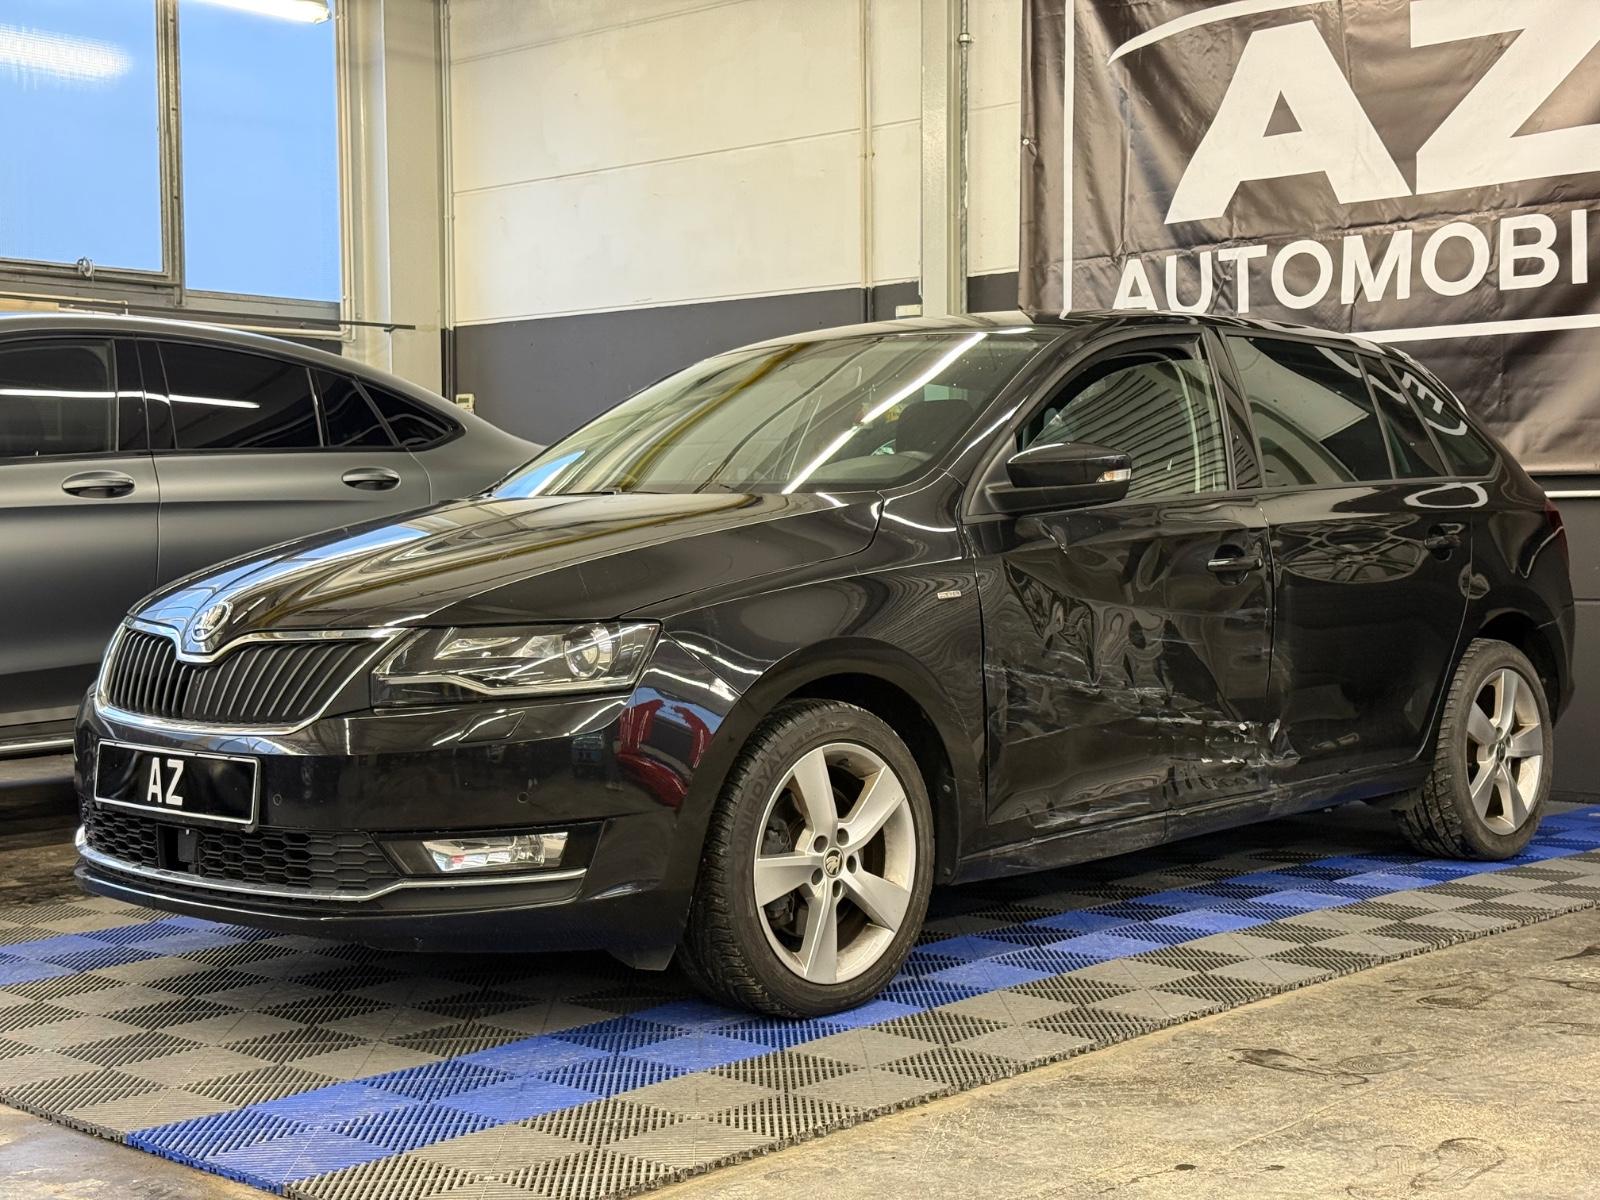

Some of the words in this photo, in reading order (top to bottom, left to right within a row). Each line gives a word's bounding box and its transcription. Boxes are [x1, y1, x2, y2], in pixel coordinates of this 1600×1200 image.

[1164, 0, 1600, 224] AZ
[1113, 210, 1588, 313] AUTOMOBI
[148, 757, 184, 806] AZ
